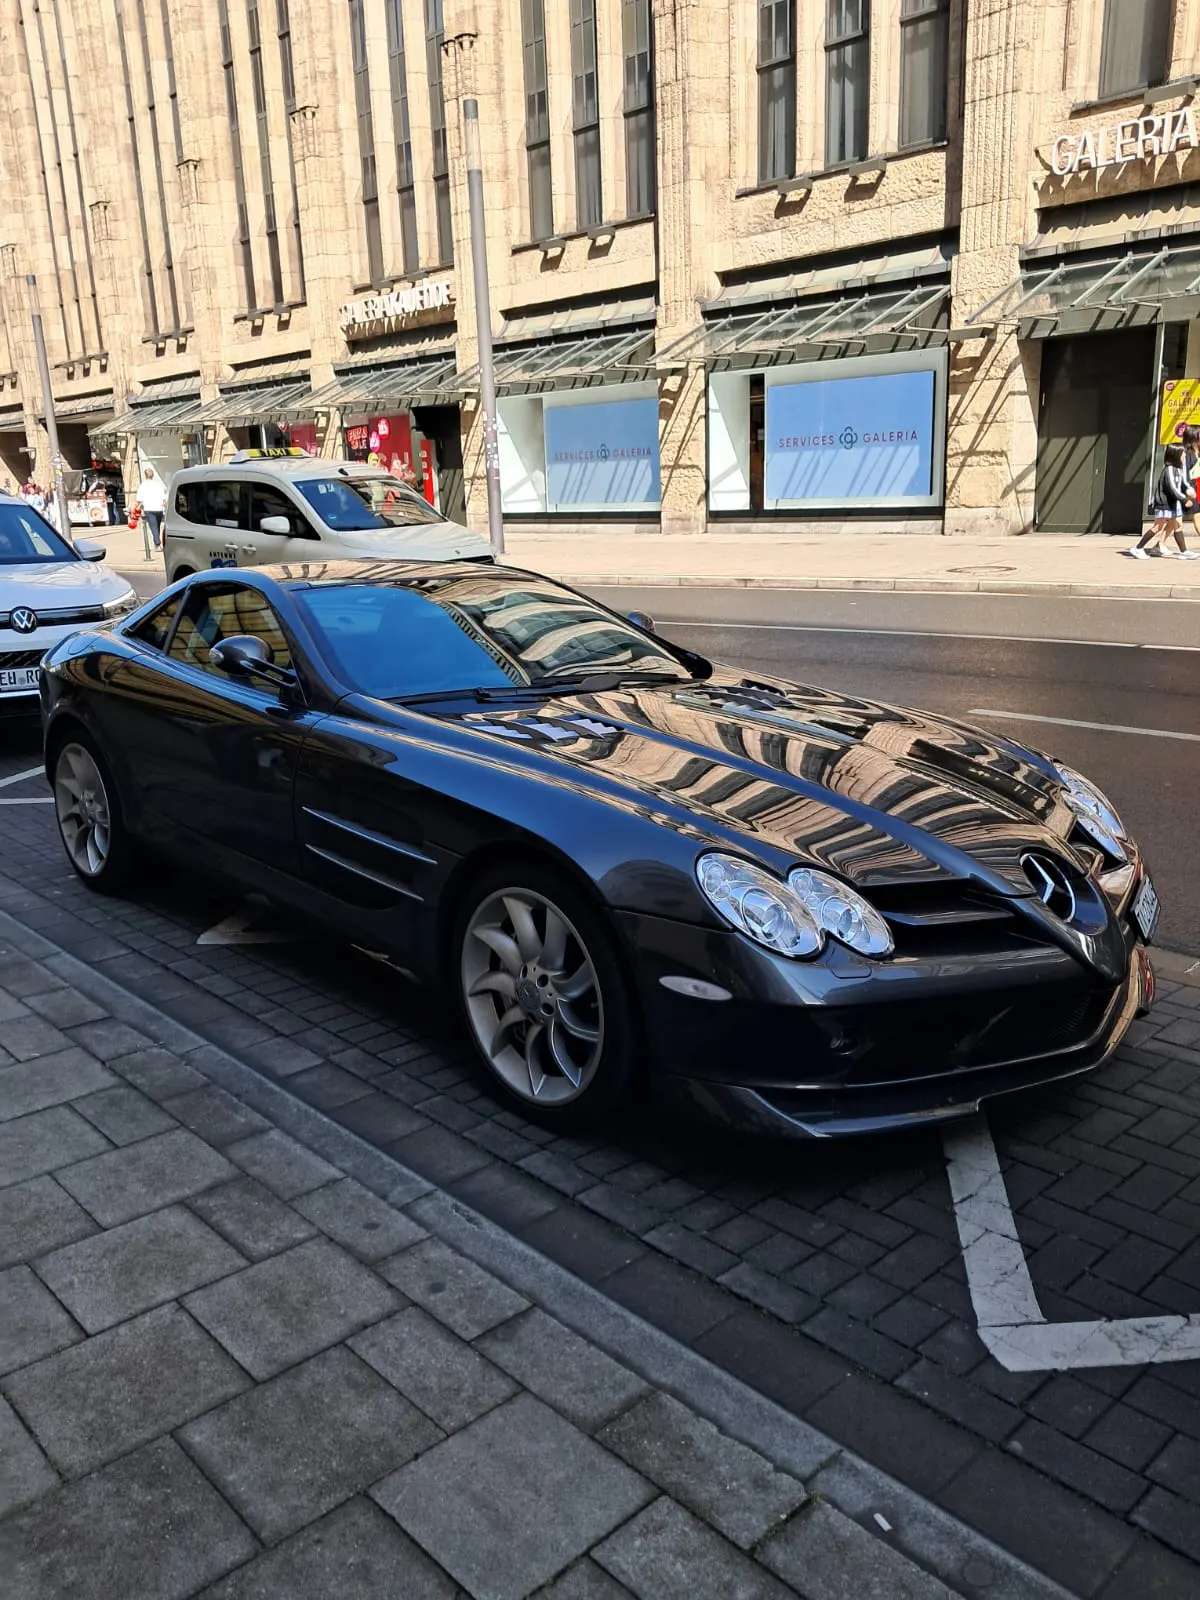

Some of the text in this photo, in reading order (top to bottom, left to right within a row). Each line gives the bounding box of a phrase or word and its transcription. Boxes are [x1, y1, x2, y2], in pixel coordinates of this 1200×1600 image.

[1051, 107, 1199, 176] GALERIA
[778, 429, 918, 449] SERVICES GALERIA
[262, 448, 288, 457] TAXI
[554, 446, 652, 461] SERVICES GALERIA
